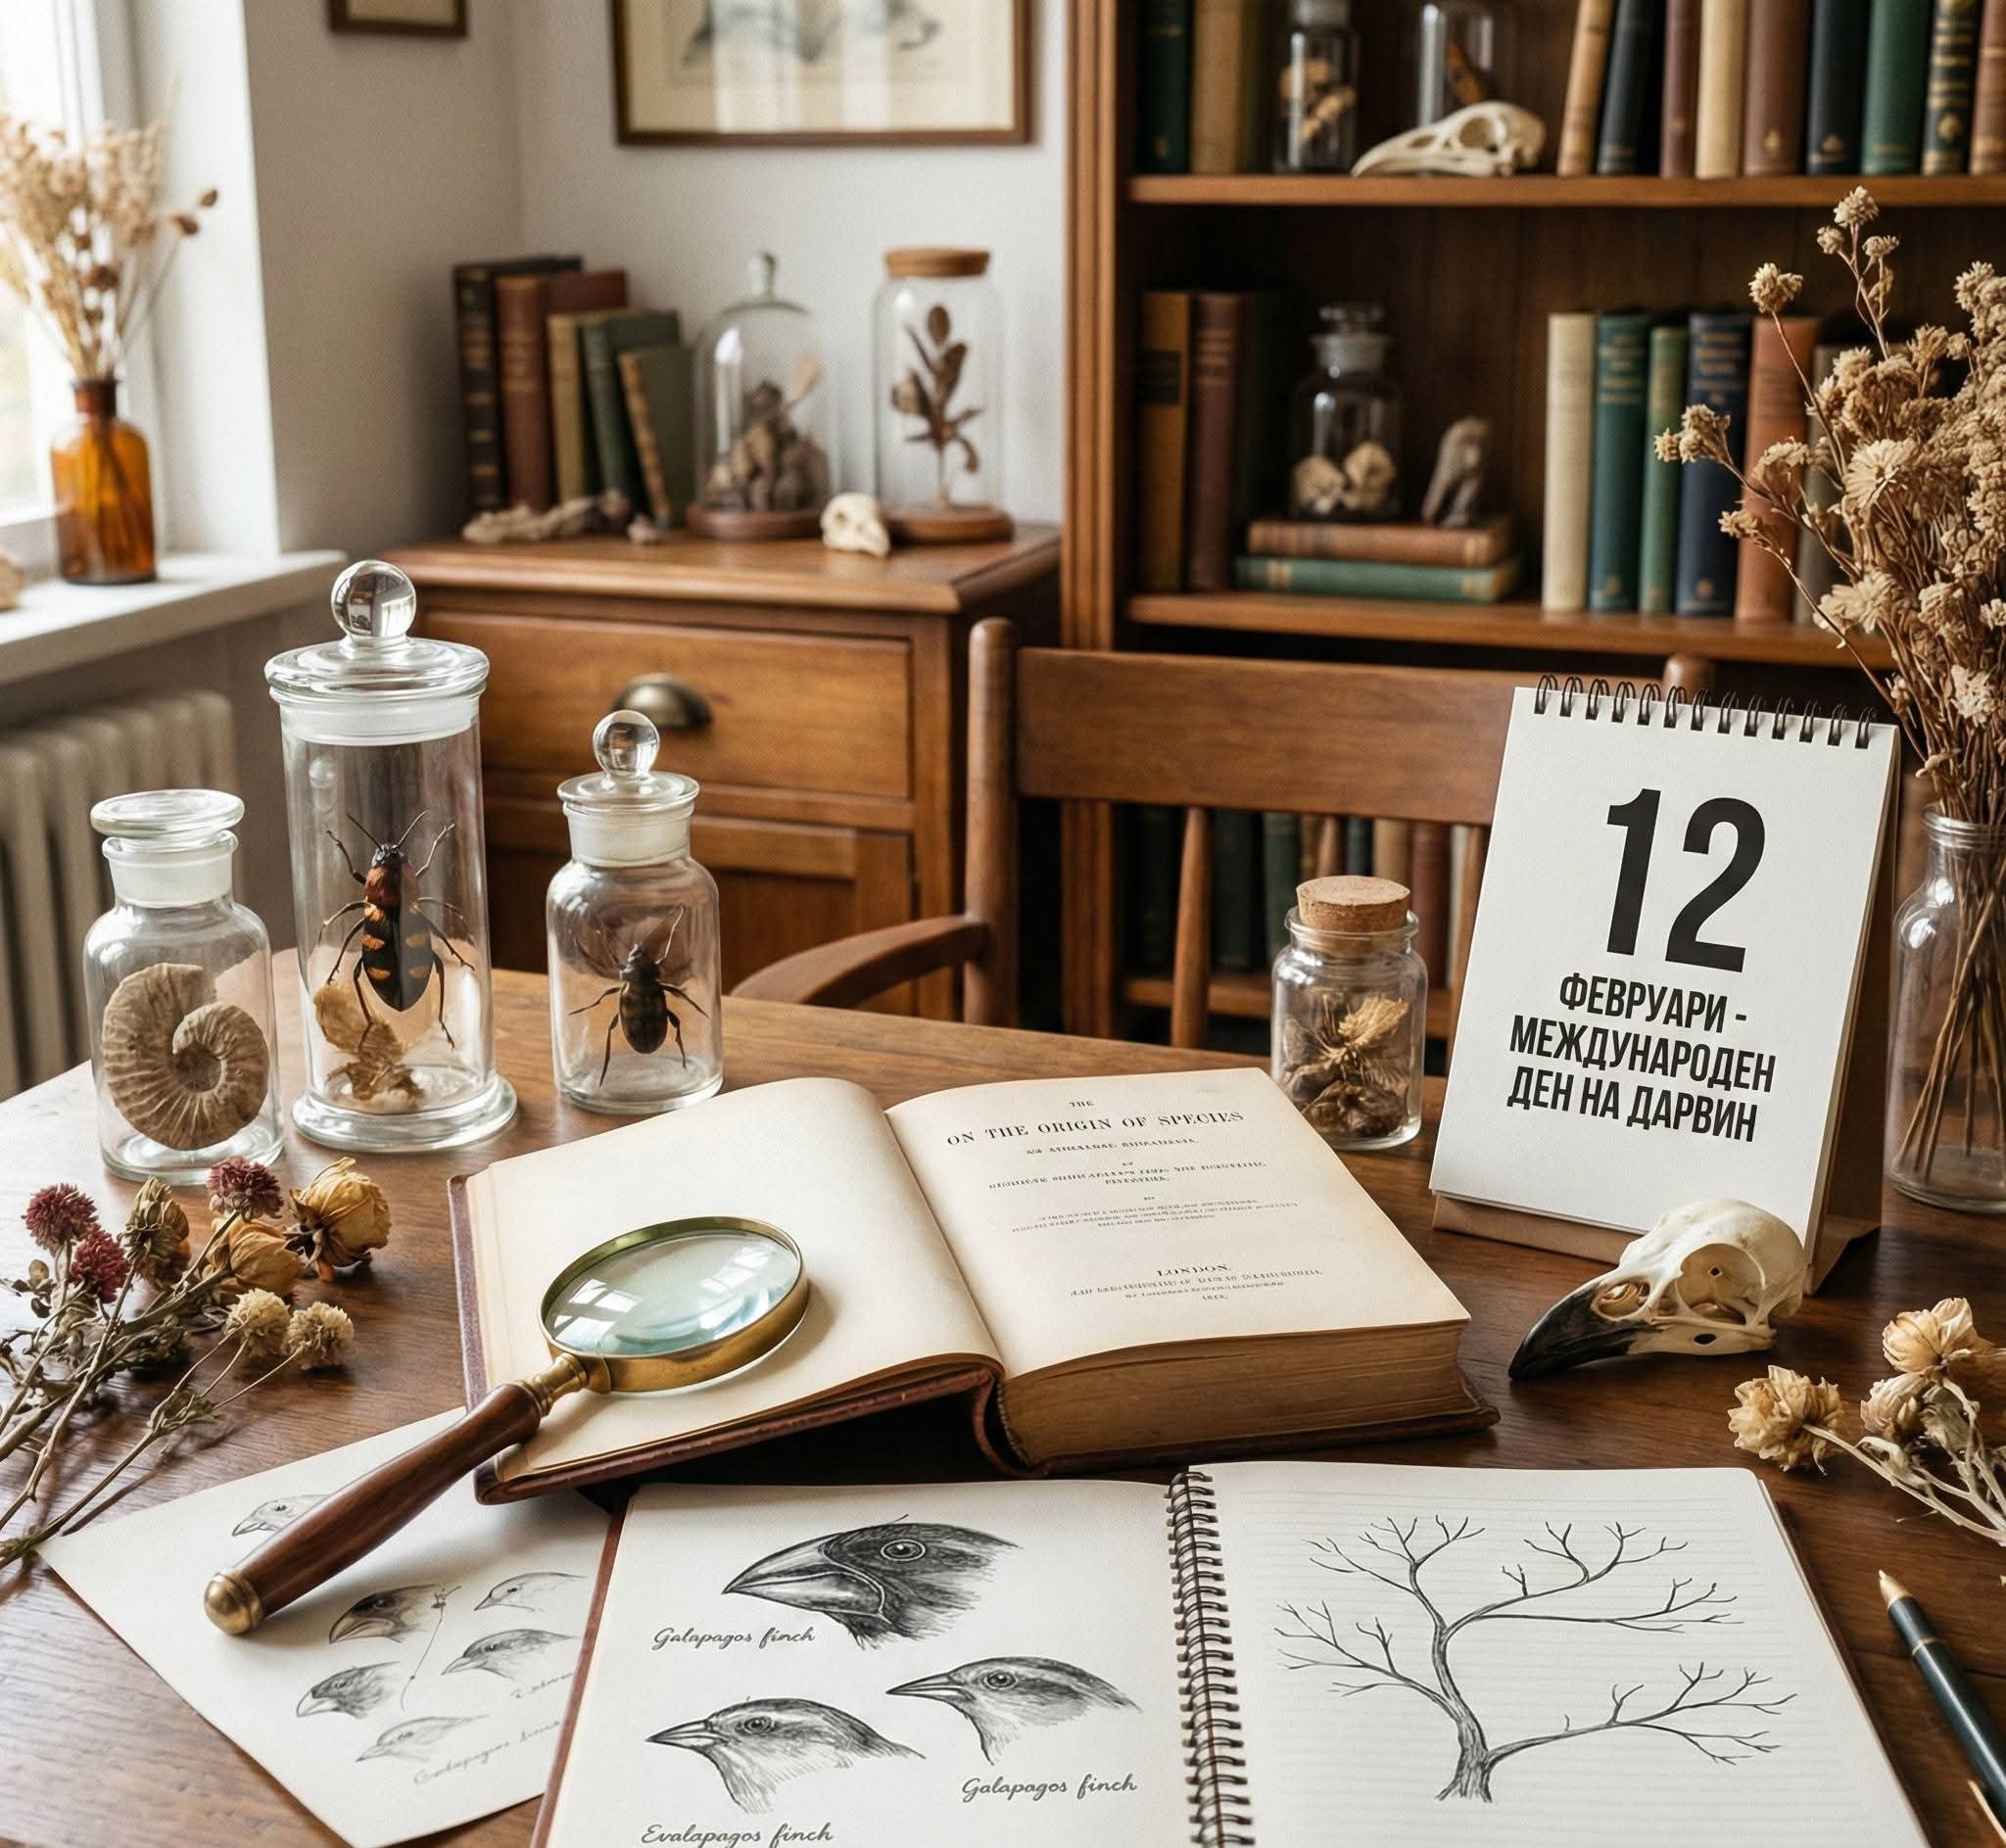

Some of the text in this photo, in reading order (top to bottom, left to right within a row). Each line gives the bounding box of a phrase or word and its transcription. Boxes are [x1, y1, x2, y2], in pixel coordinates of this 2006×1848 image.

[1606, 787, 1766, 973] 12
[1558, 971, 1729, 1033] ФЕВРУАРИ
[1508, 1015, 1777, 1094] МЕЖДУНАРОДЕН
[947, 1111, 1245, 1146] ON THE ORIGIN OF SPECIES
[1506, 1066, 1759, 1144] ДЕН НА ДАРВИН
[651, 1626, 815, 1651] Galapagos finch
[962, 1773, 1138, 1803] Galapagos finch
[641, 1822, 835, 1848] Evalapagos finch
